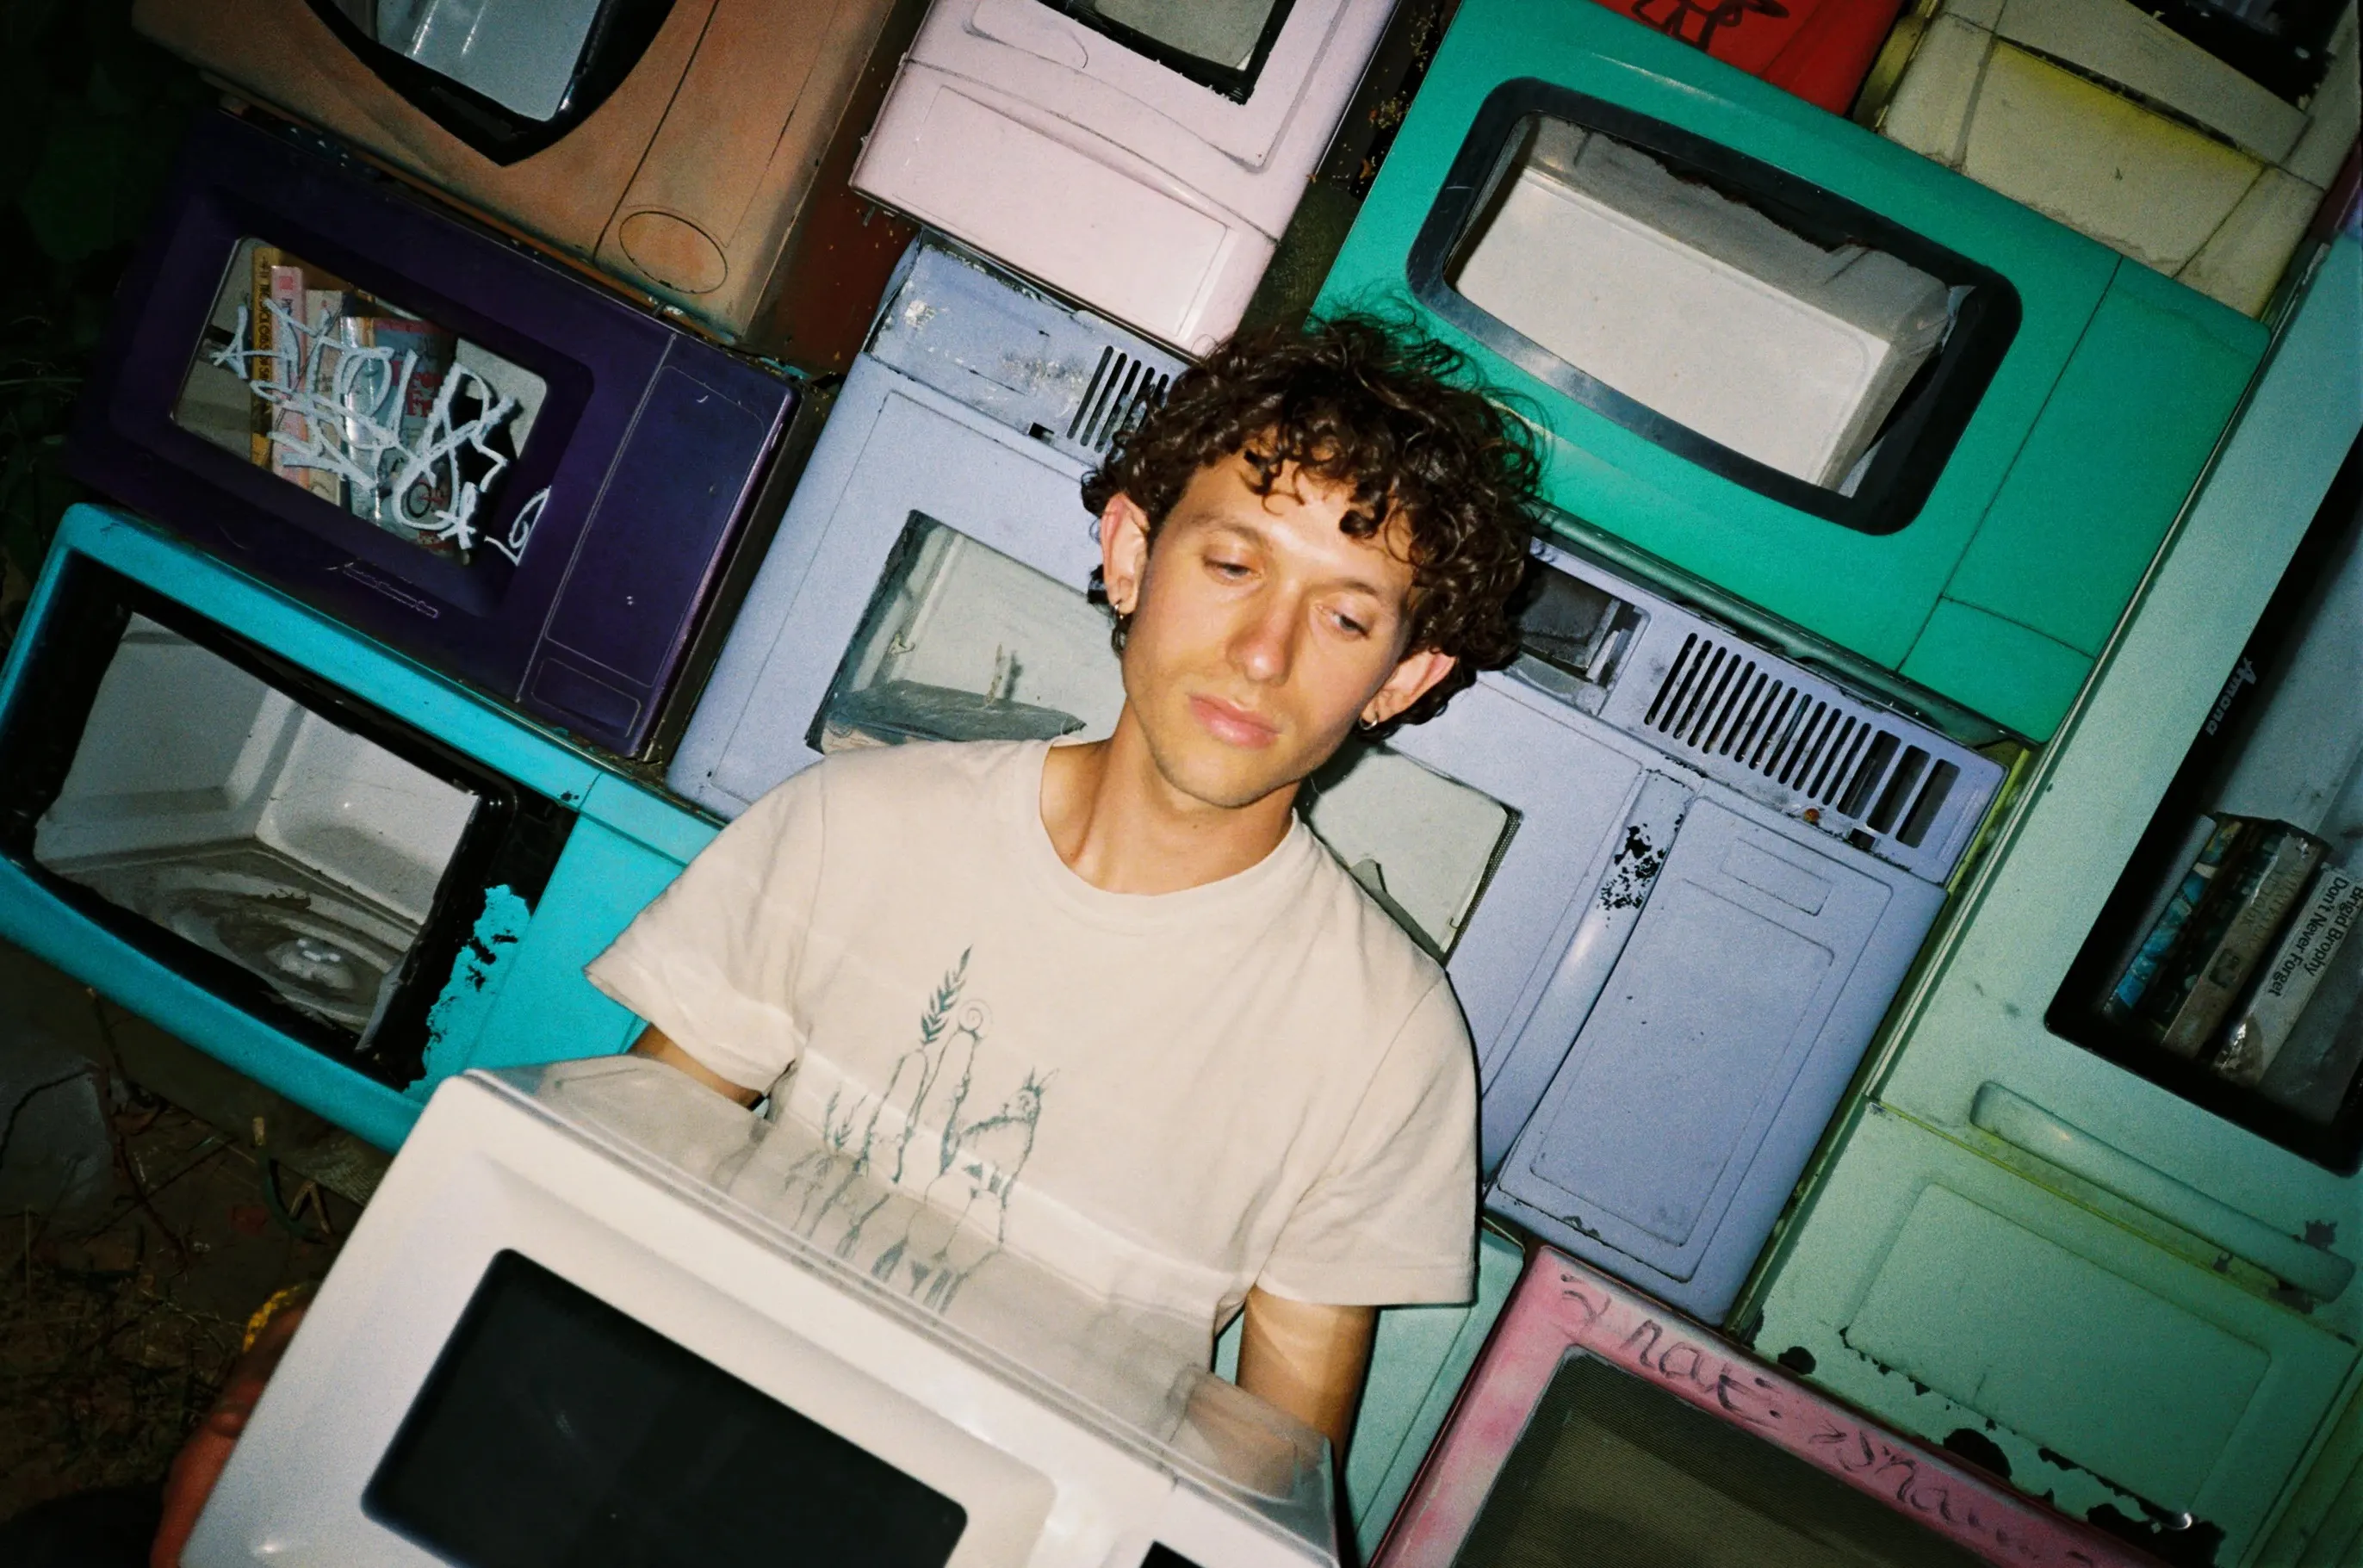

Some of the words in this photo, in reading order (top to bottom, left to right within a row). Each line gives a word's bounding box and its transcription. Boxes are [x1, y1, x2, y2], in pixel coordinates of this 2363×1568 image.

[2205, 656, 2258, 736] Amana
[2318, 877, 2349, 912] Don't
[2334, 885, 2363, 928] Brigid
[2294, 912, 2327, 953] Never
[2303, 927, 2344, 976] Brophy
[2268, 952, 2304, 997] Forget
